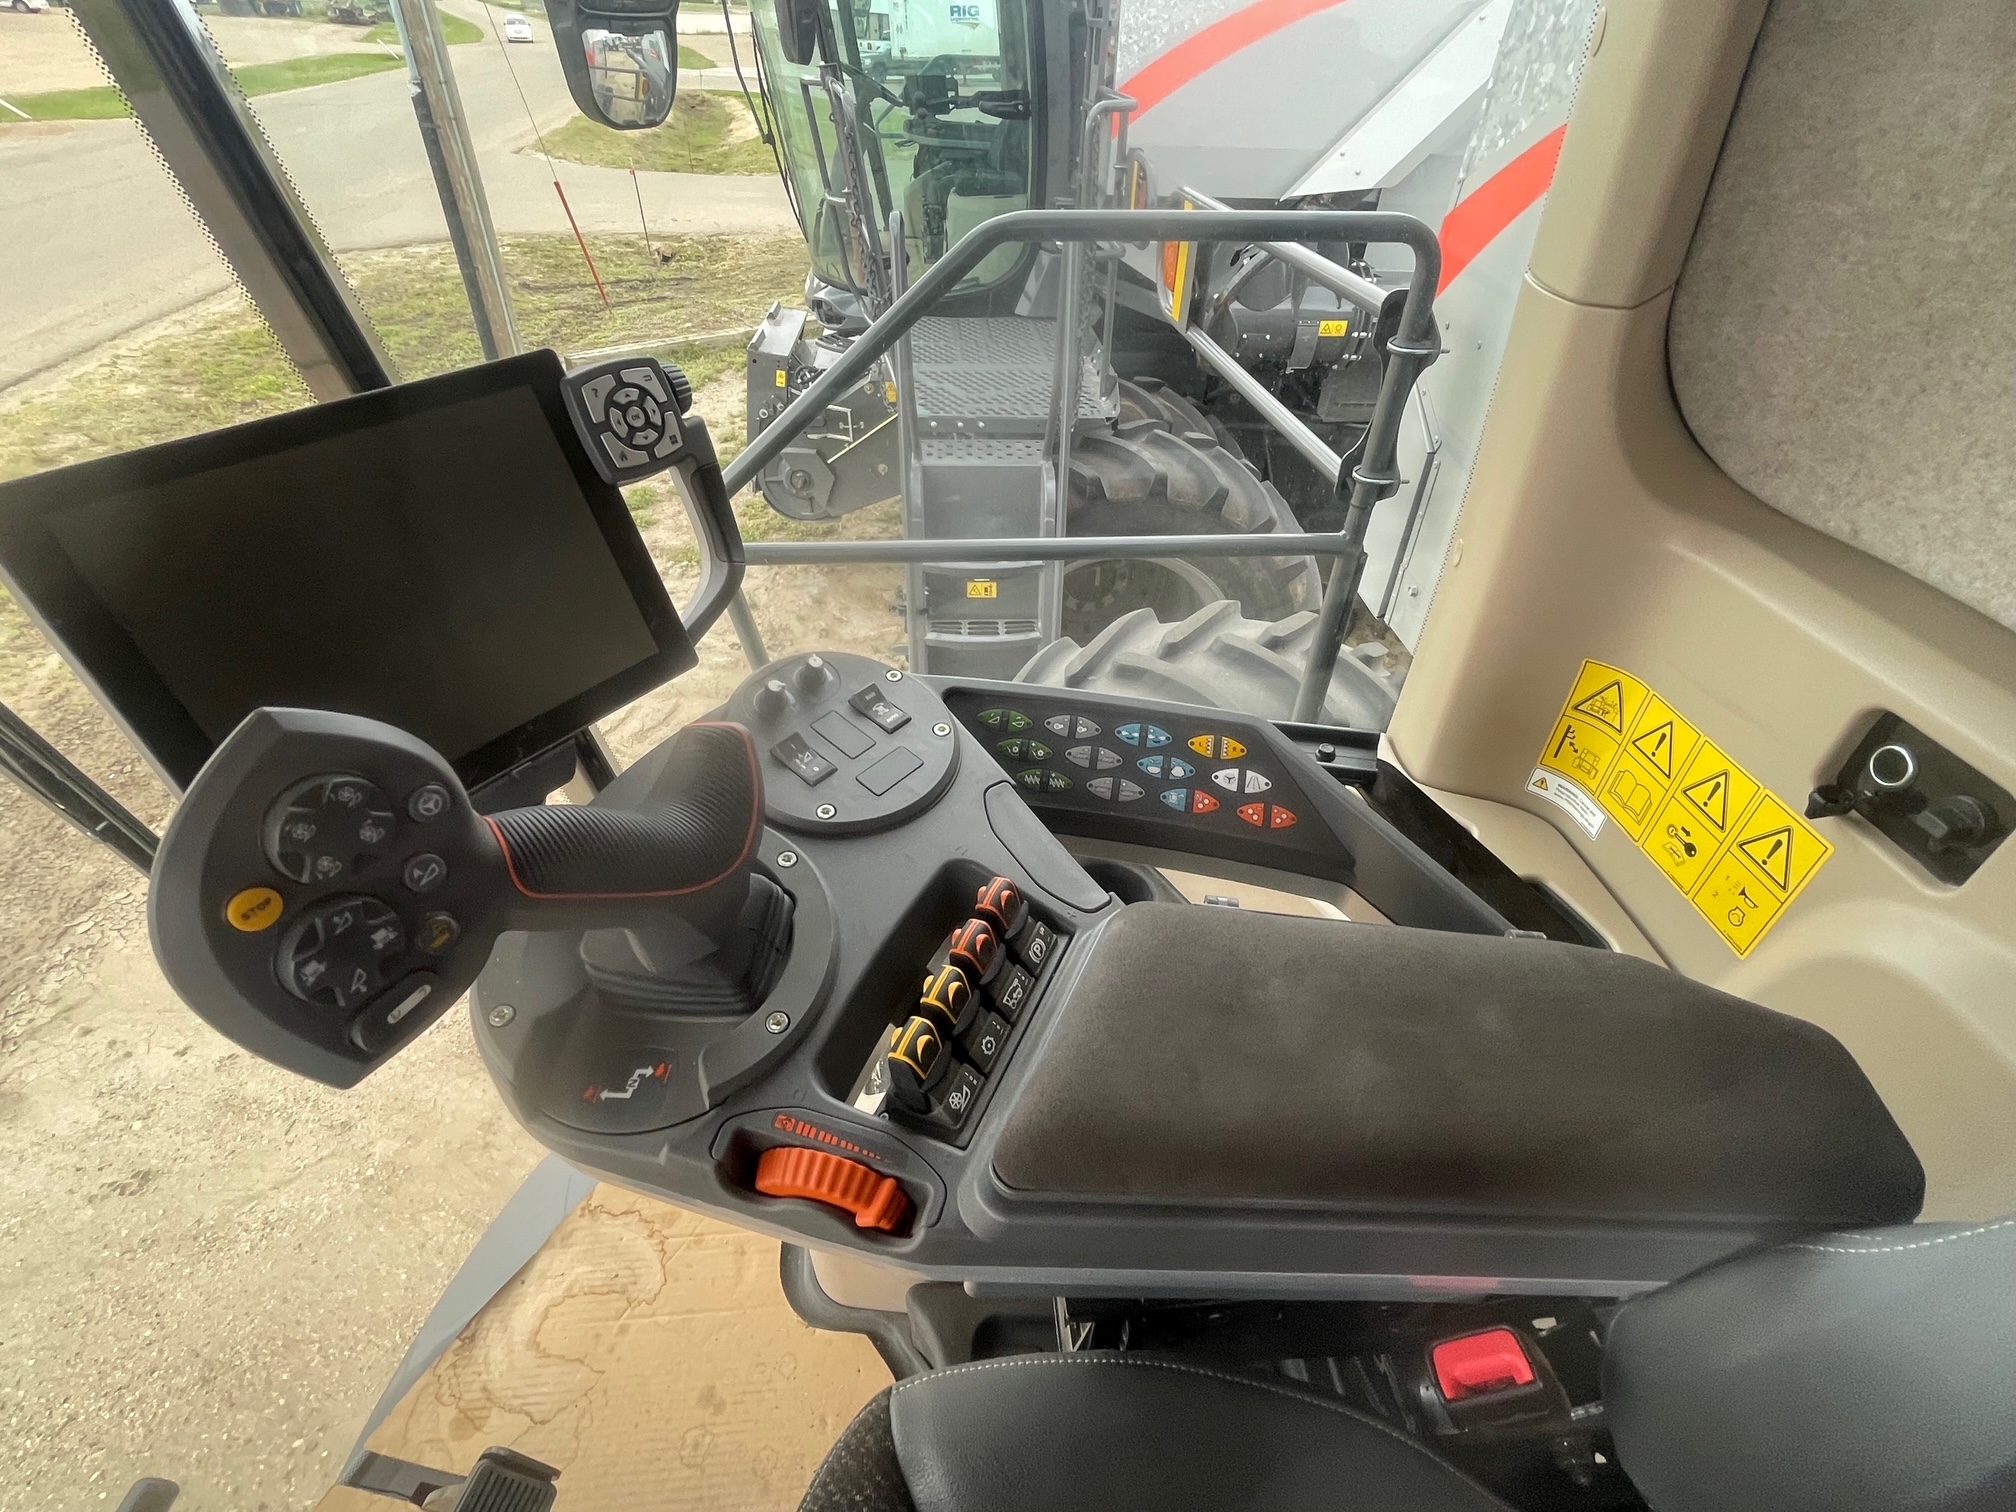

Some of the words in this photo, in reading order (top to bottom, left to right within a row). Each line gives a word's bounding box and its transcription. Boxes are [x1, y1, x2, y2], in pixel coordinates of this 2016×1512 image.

[950, 5, 980, 17] RIG
[631, 413, 641, 421] OK
[886, 713, 899, 723] AUTO
[240, 897, 272, 922] STOP
